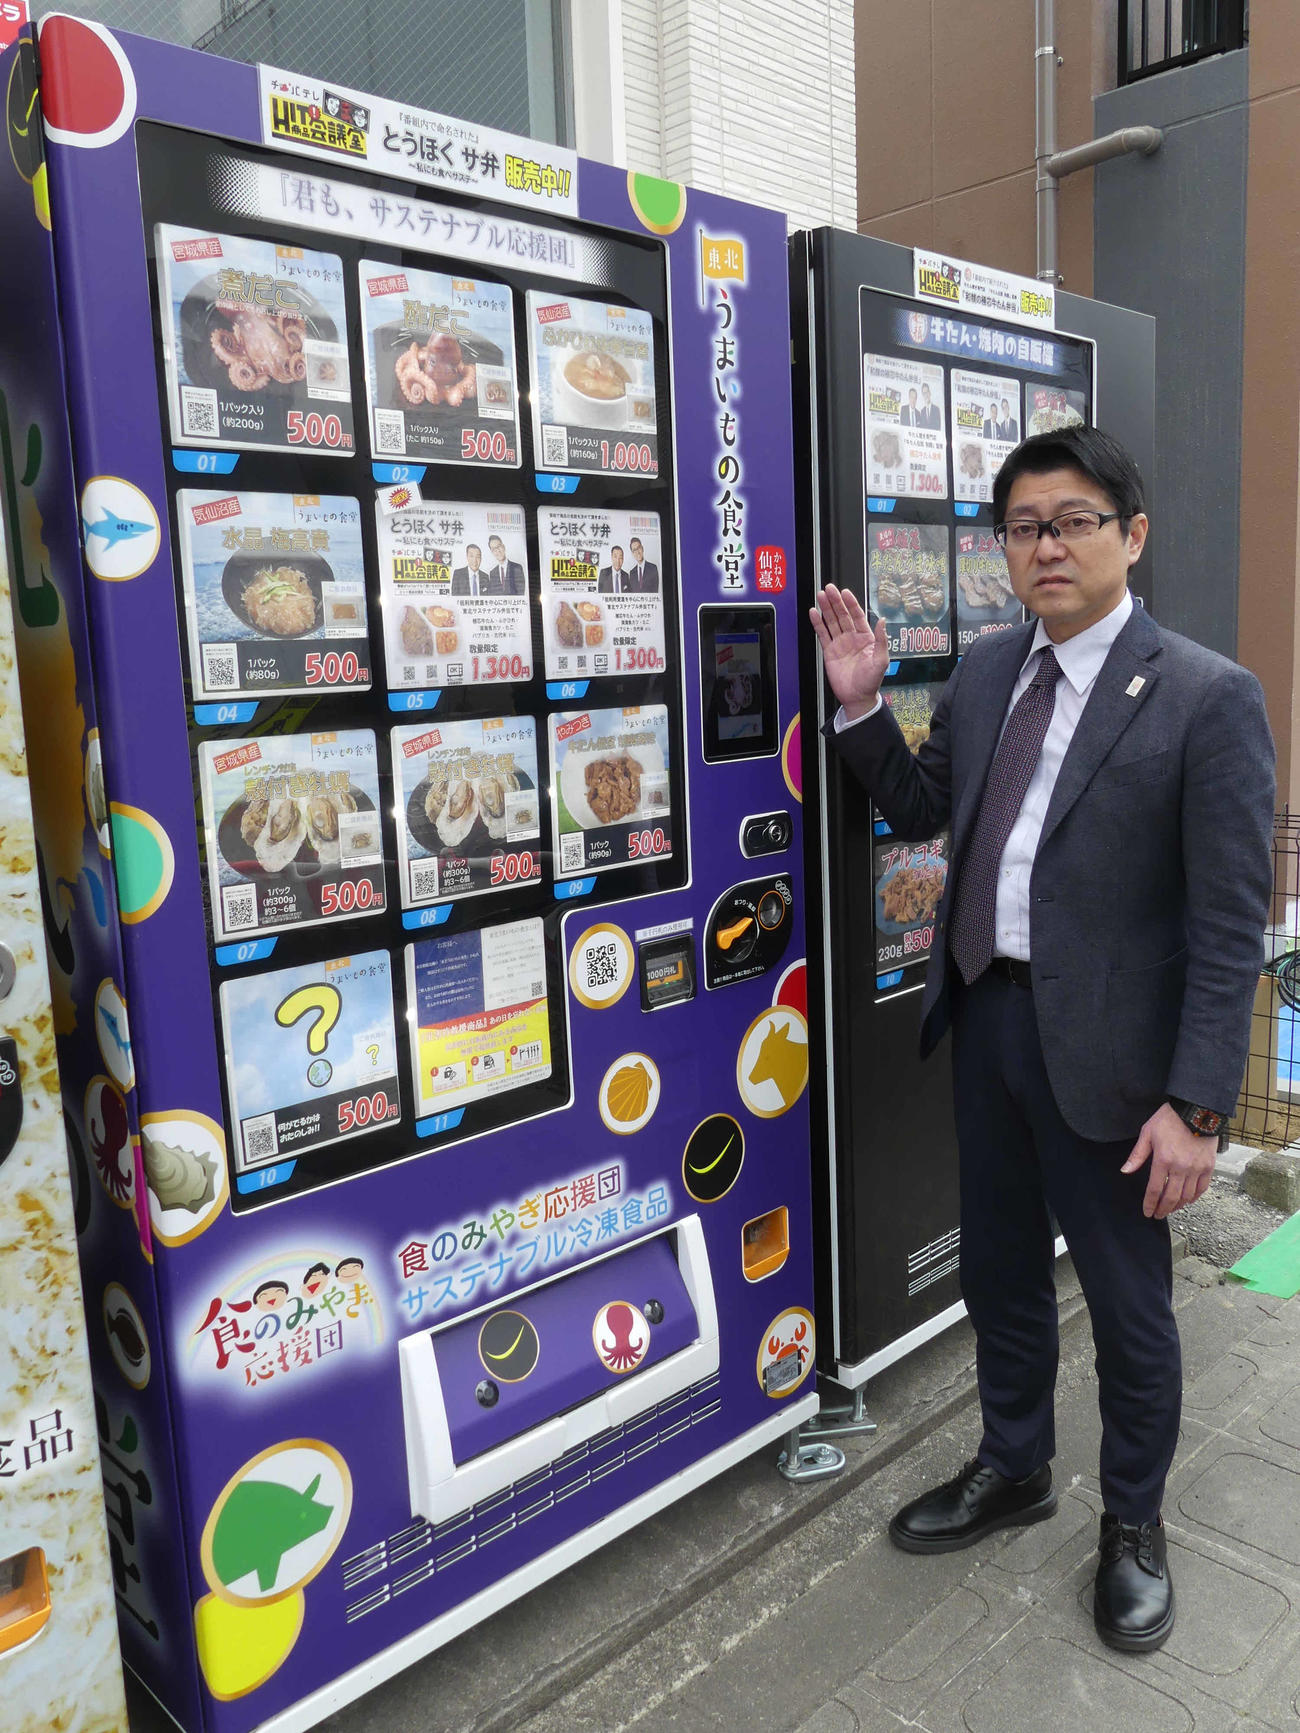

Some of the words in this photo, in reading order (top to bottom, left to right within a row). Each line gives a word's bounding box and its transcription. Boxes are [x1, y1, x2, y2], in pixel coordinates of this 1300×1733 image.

[383, 125, 453, 166] とうほく
[461, 146, 500, 179] サ弁
[504, 153, 571, 199] 販売中!!
[171, 239, 223, 260] 宮城県産
[707, 247, 739, 270] 東北
[218, 268, 300, 310] 煮だこ
[367, 275, 409, 297] 宮城県産
[402, 299, 472, 337] 酢だこ
[537, 303, 571, 324] 気仙沼産
[220, 401, 264, 416] 1パック入り
[222, 416, 264, 431] (約200g)
[287, 410, 353, 448] 500円
[461, 428, 516, 463] 500円
[714, 287, 745, 590] うまいもの食堂
[197, 454, 217, 472] 01
[600, 440, 658, 473] 1,000円
[392, 466, 409, 482] 02
[551, 478, 566, 490] 03
[192, 497, 242, 525] 気仙沼産
[877, 500, 887, 510] 01
[963, 504, 972, 515] 02
[391, 518, 435, 534] とうほく
[439, 520, 464, 536] サ弁
[550, 521, 587, 536] とうほく
[590, 523, 611, 538] サ弁
[758, 550, 773, 589] 仙臺
[908, 626, 948, 652] 1000円
[248, 658, 276, 668] 1パック
[304, 651, 369, 686] 500円
[472, 655, 531, 680] 1,300円
[615, 647, 665, 671] 1,300円
[245, 669, 280, 681] (約80g)
[561, 683, 576, 696] 06
[407, 693, 424, 708] 05
[217, 705, 238, 722] 04
[556, 713, 592, 740] やみつき
[402, 729, 442, 758] 宮城県産
[213, 743, 262, 773] 宮城県産
[590, 840, 610, 849] 1パック
[628, 828, 671, 859] 500円
[447, 859, 466, 868] 1パック
[588, 849, 612, 860] (約90g)
[881, 839, 944, 875] プルコギ
[442, 867, 471, 879] (約300g)
[490, 851, 541, 885] 500円
[267, 886, 291, 896] 1パック
[321, 878, 383, 916] 500円
[568, 881, 584, 895] 09
[262, 894, 297, 907] (約300g)
[420, 909, 437, 924] 08
[236, 943, 257, 962] 07
[878, 943, 903, 962] 230g
[646, 965, 677, 980] 1000円札
[886, 974, 895, 985] 10
[338, 1091, 398, 1133] 500円
[278, 1113, 321, 1133] 何がでるかは
[434, 1116, 447, 1132] 11
[279, 1124, 321, 1144] おたのしみ!!
[259, 1168, 277, 1186] 10
[398, 1165, 622, 1279] 食のみやぎ応援団
[402, 1186, 670, 1320] サステナブル冷凍食品
[194, 1282, 375, 1370] 食のみやぎ
[244, 1319, 344, 1388] 応援団
